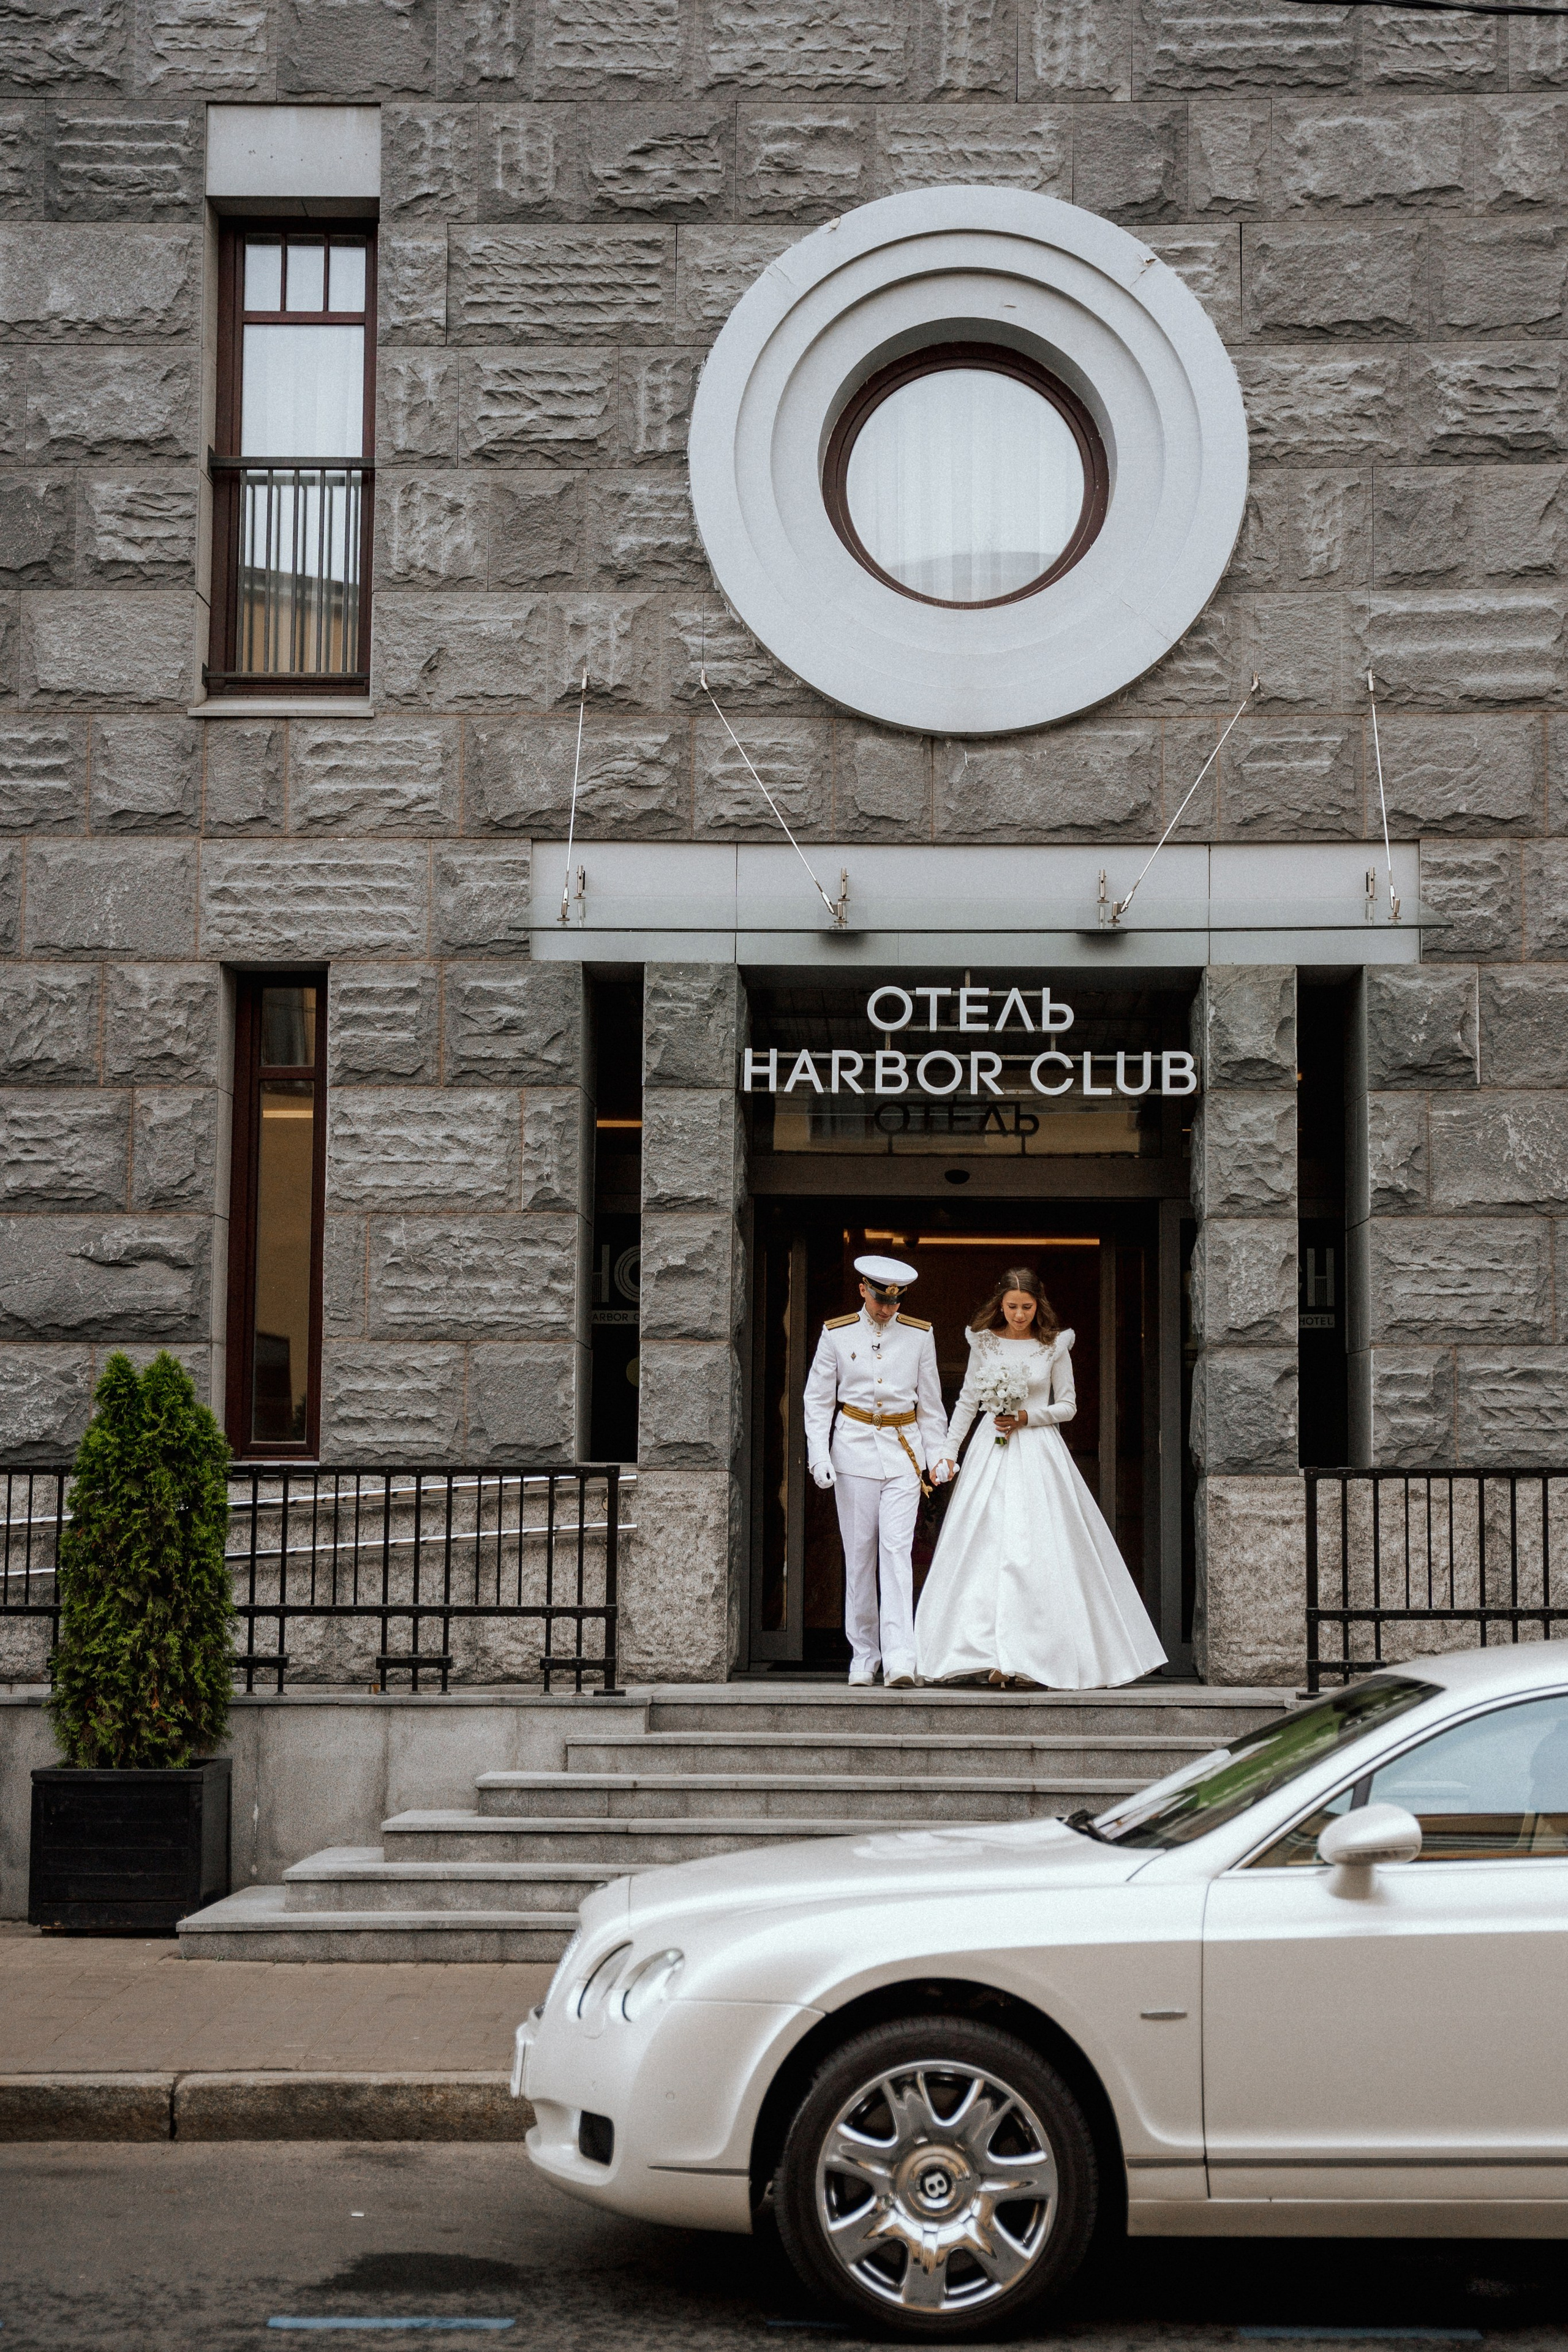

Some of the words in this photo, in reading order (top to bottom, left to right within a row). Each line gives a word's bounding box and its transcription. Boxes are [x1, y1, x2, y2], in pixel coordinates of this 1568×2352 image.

[867, 986, 1074, 1033] ОТЕЛЬ
[743, 1047, 1005, 1095] HARBOR
[1030, 1050, 1197, 1096] CLUB
[592, 1313, 628, 1322] ARBOR
[1298, 1317, 1333, 1325] HOTEL
[925, 2172, 948, 2198] B
